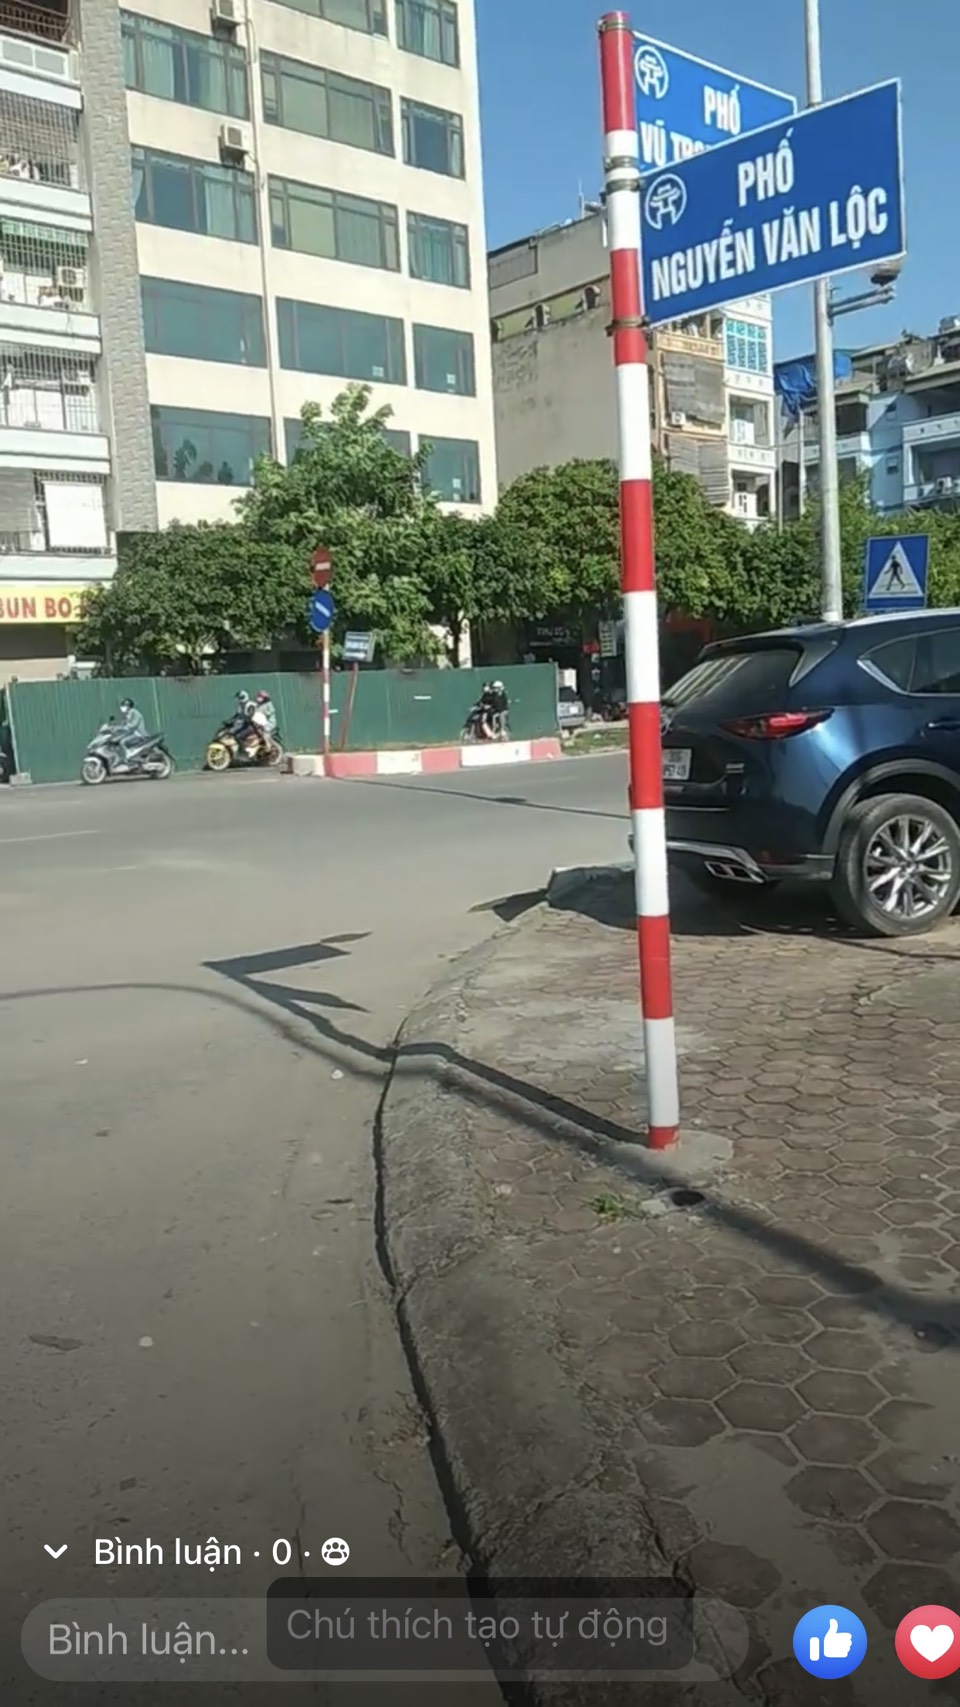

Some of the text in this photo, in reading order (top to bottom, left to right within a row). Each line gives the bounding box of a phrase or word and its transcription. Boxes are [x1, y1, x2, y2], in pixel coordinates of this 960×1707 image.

[704, 84, 741, 135] PHỐ
[640, 120, 666, 166] VŨ
[737, 127, 794, 208] PHỐ
[651, 184, 888, 301] NGUYỄN VĂN LỘC
